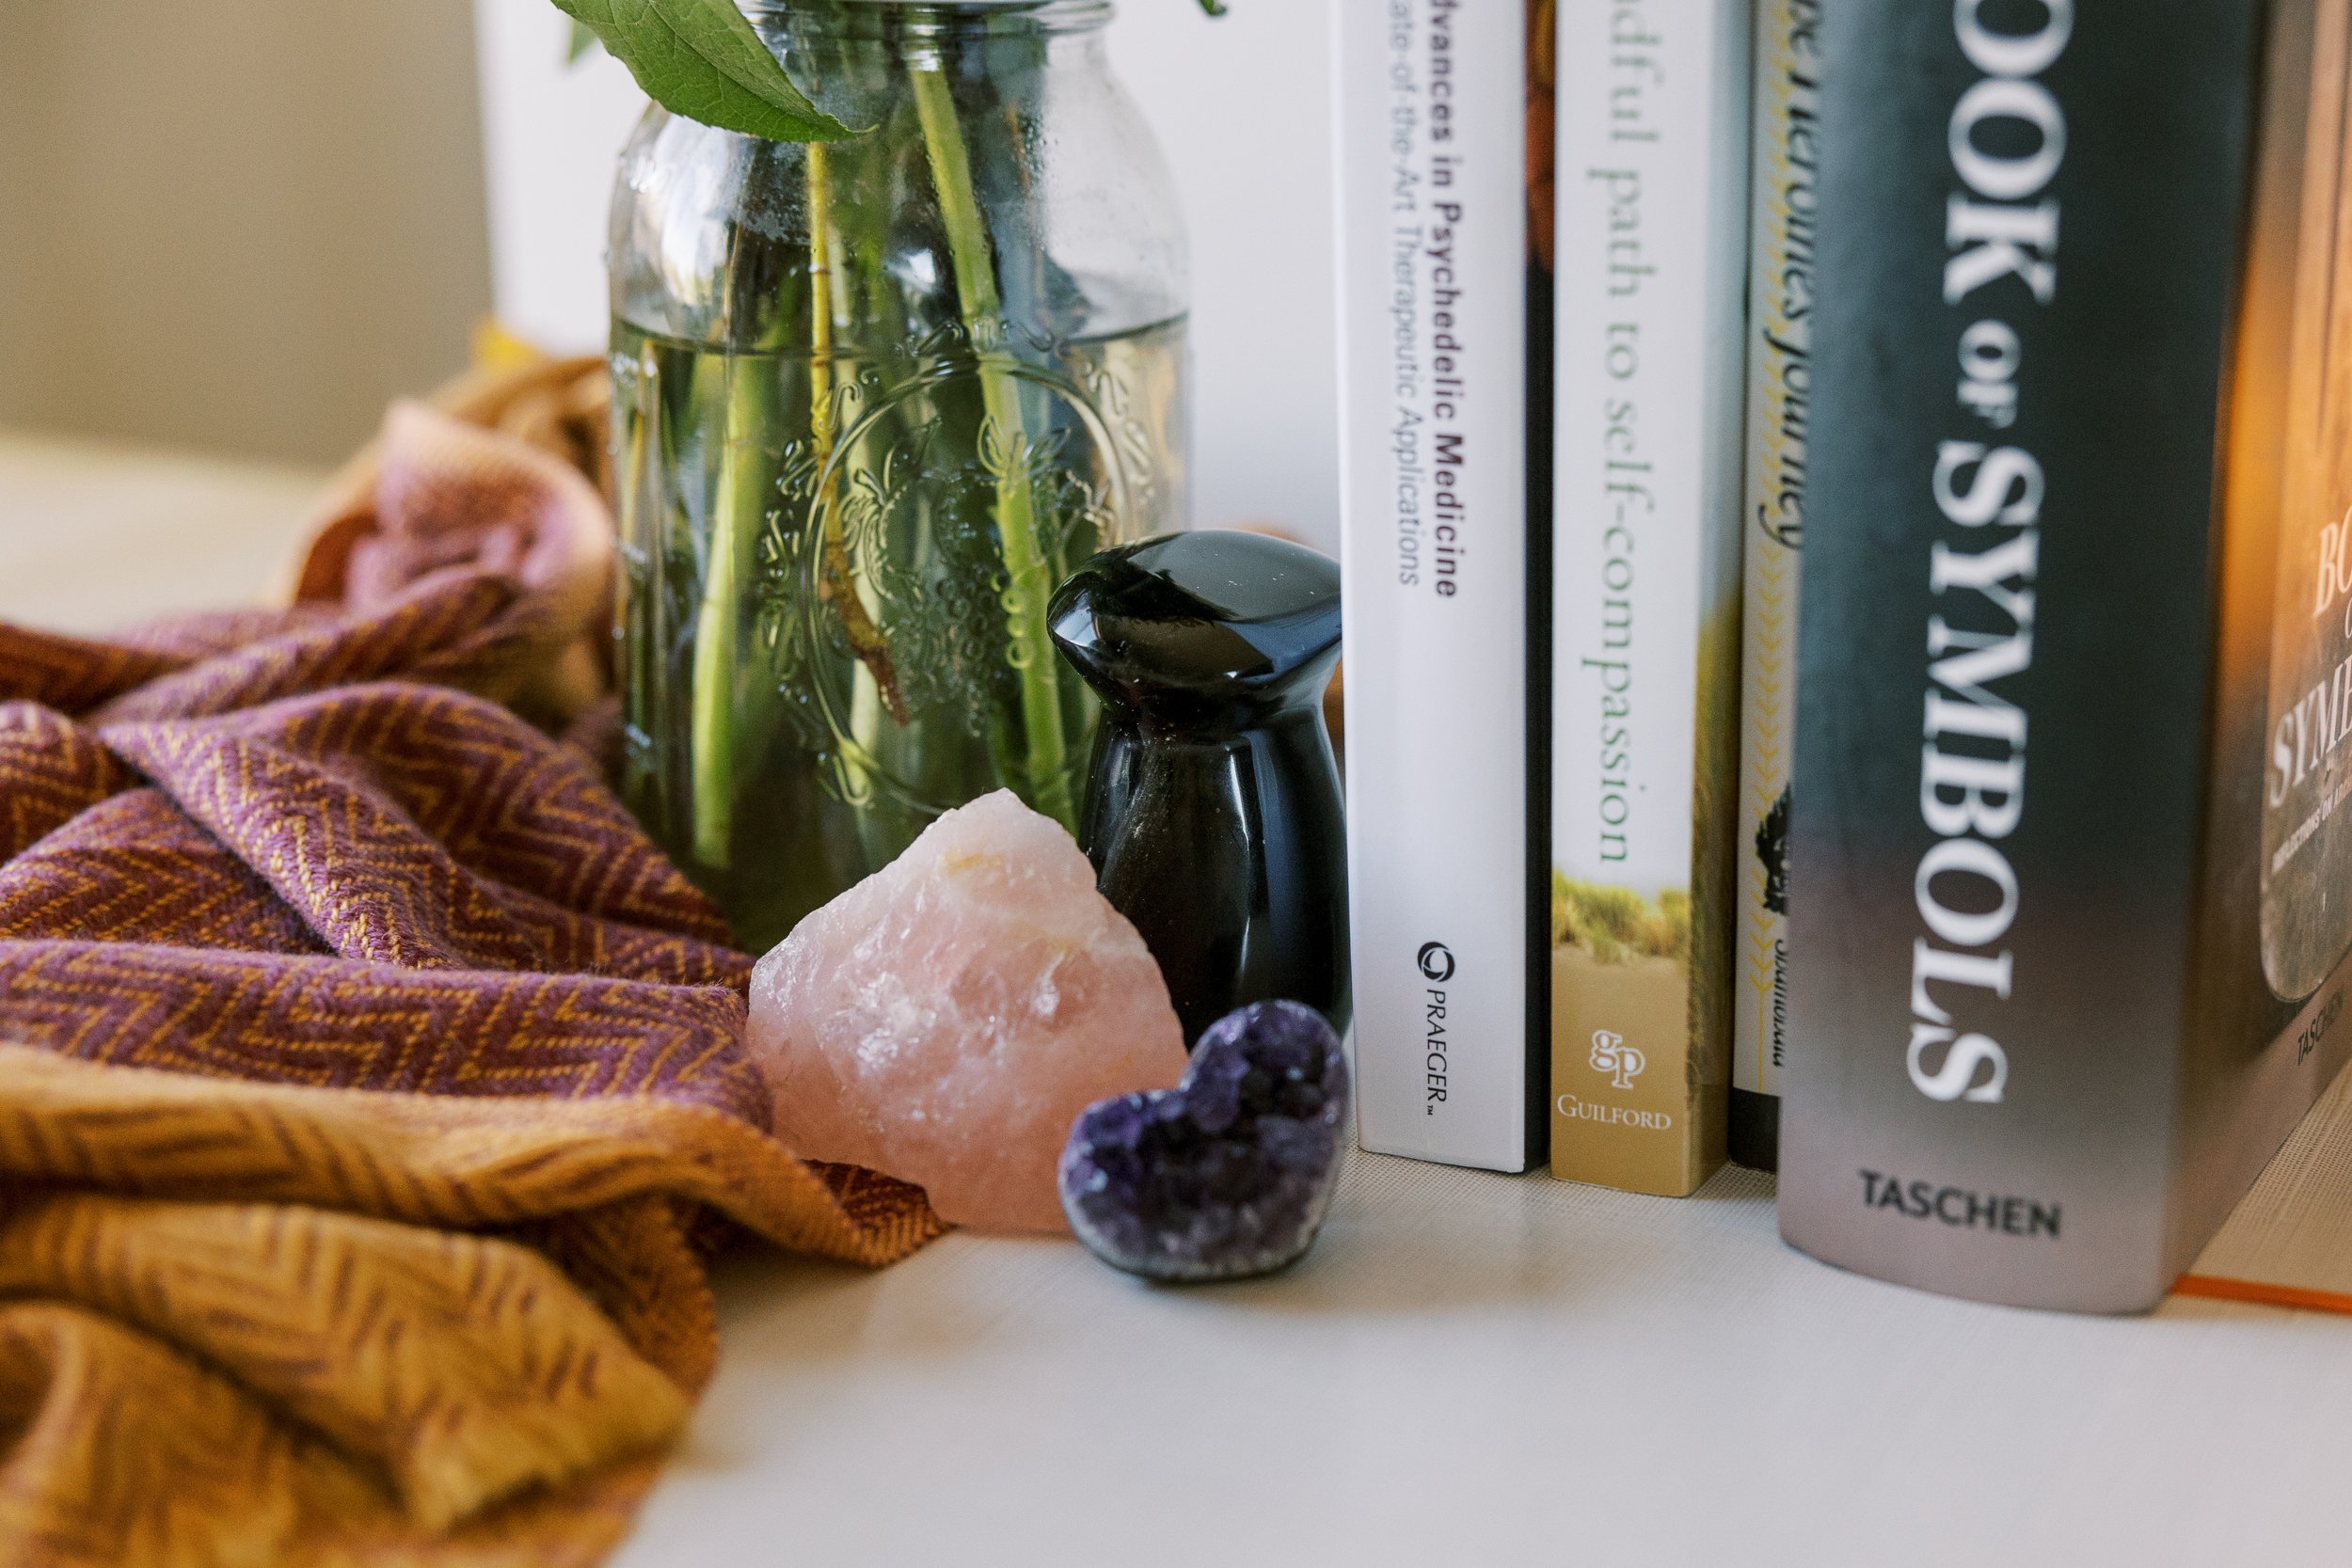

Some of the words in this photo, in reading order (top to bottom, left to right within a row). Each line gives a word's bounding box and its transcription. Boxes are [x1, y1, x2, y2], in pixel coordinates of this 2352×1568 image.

[1431, 156, 1463, 188] in
[1586, 166, 1660, 297] path
[1388, 223, 1424, 400] Therapeutic
[1425, 202, 1465, 420] Psychedelic
[1605, 322, 1643, 381] to
[1391, 405, 1427, 587] Applications
[1434, 433, 1466, 598] Medicine
[1581, 399, 1656, 864] self-compassion
[1906, 438, 2046, 1105] SYMBOLS
[1426, 988, 1448, 1102] PRAEGER
[1556, 1094, 1673, 1130] GUILFORD
[1857, 1167, 2062, 1239] TASCHEN
